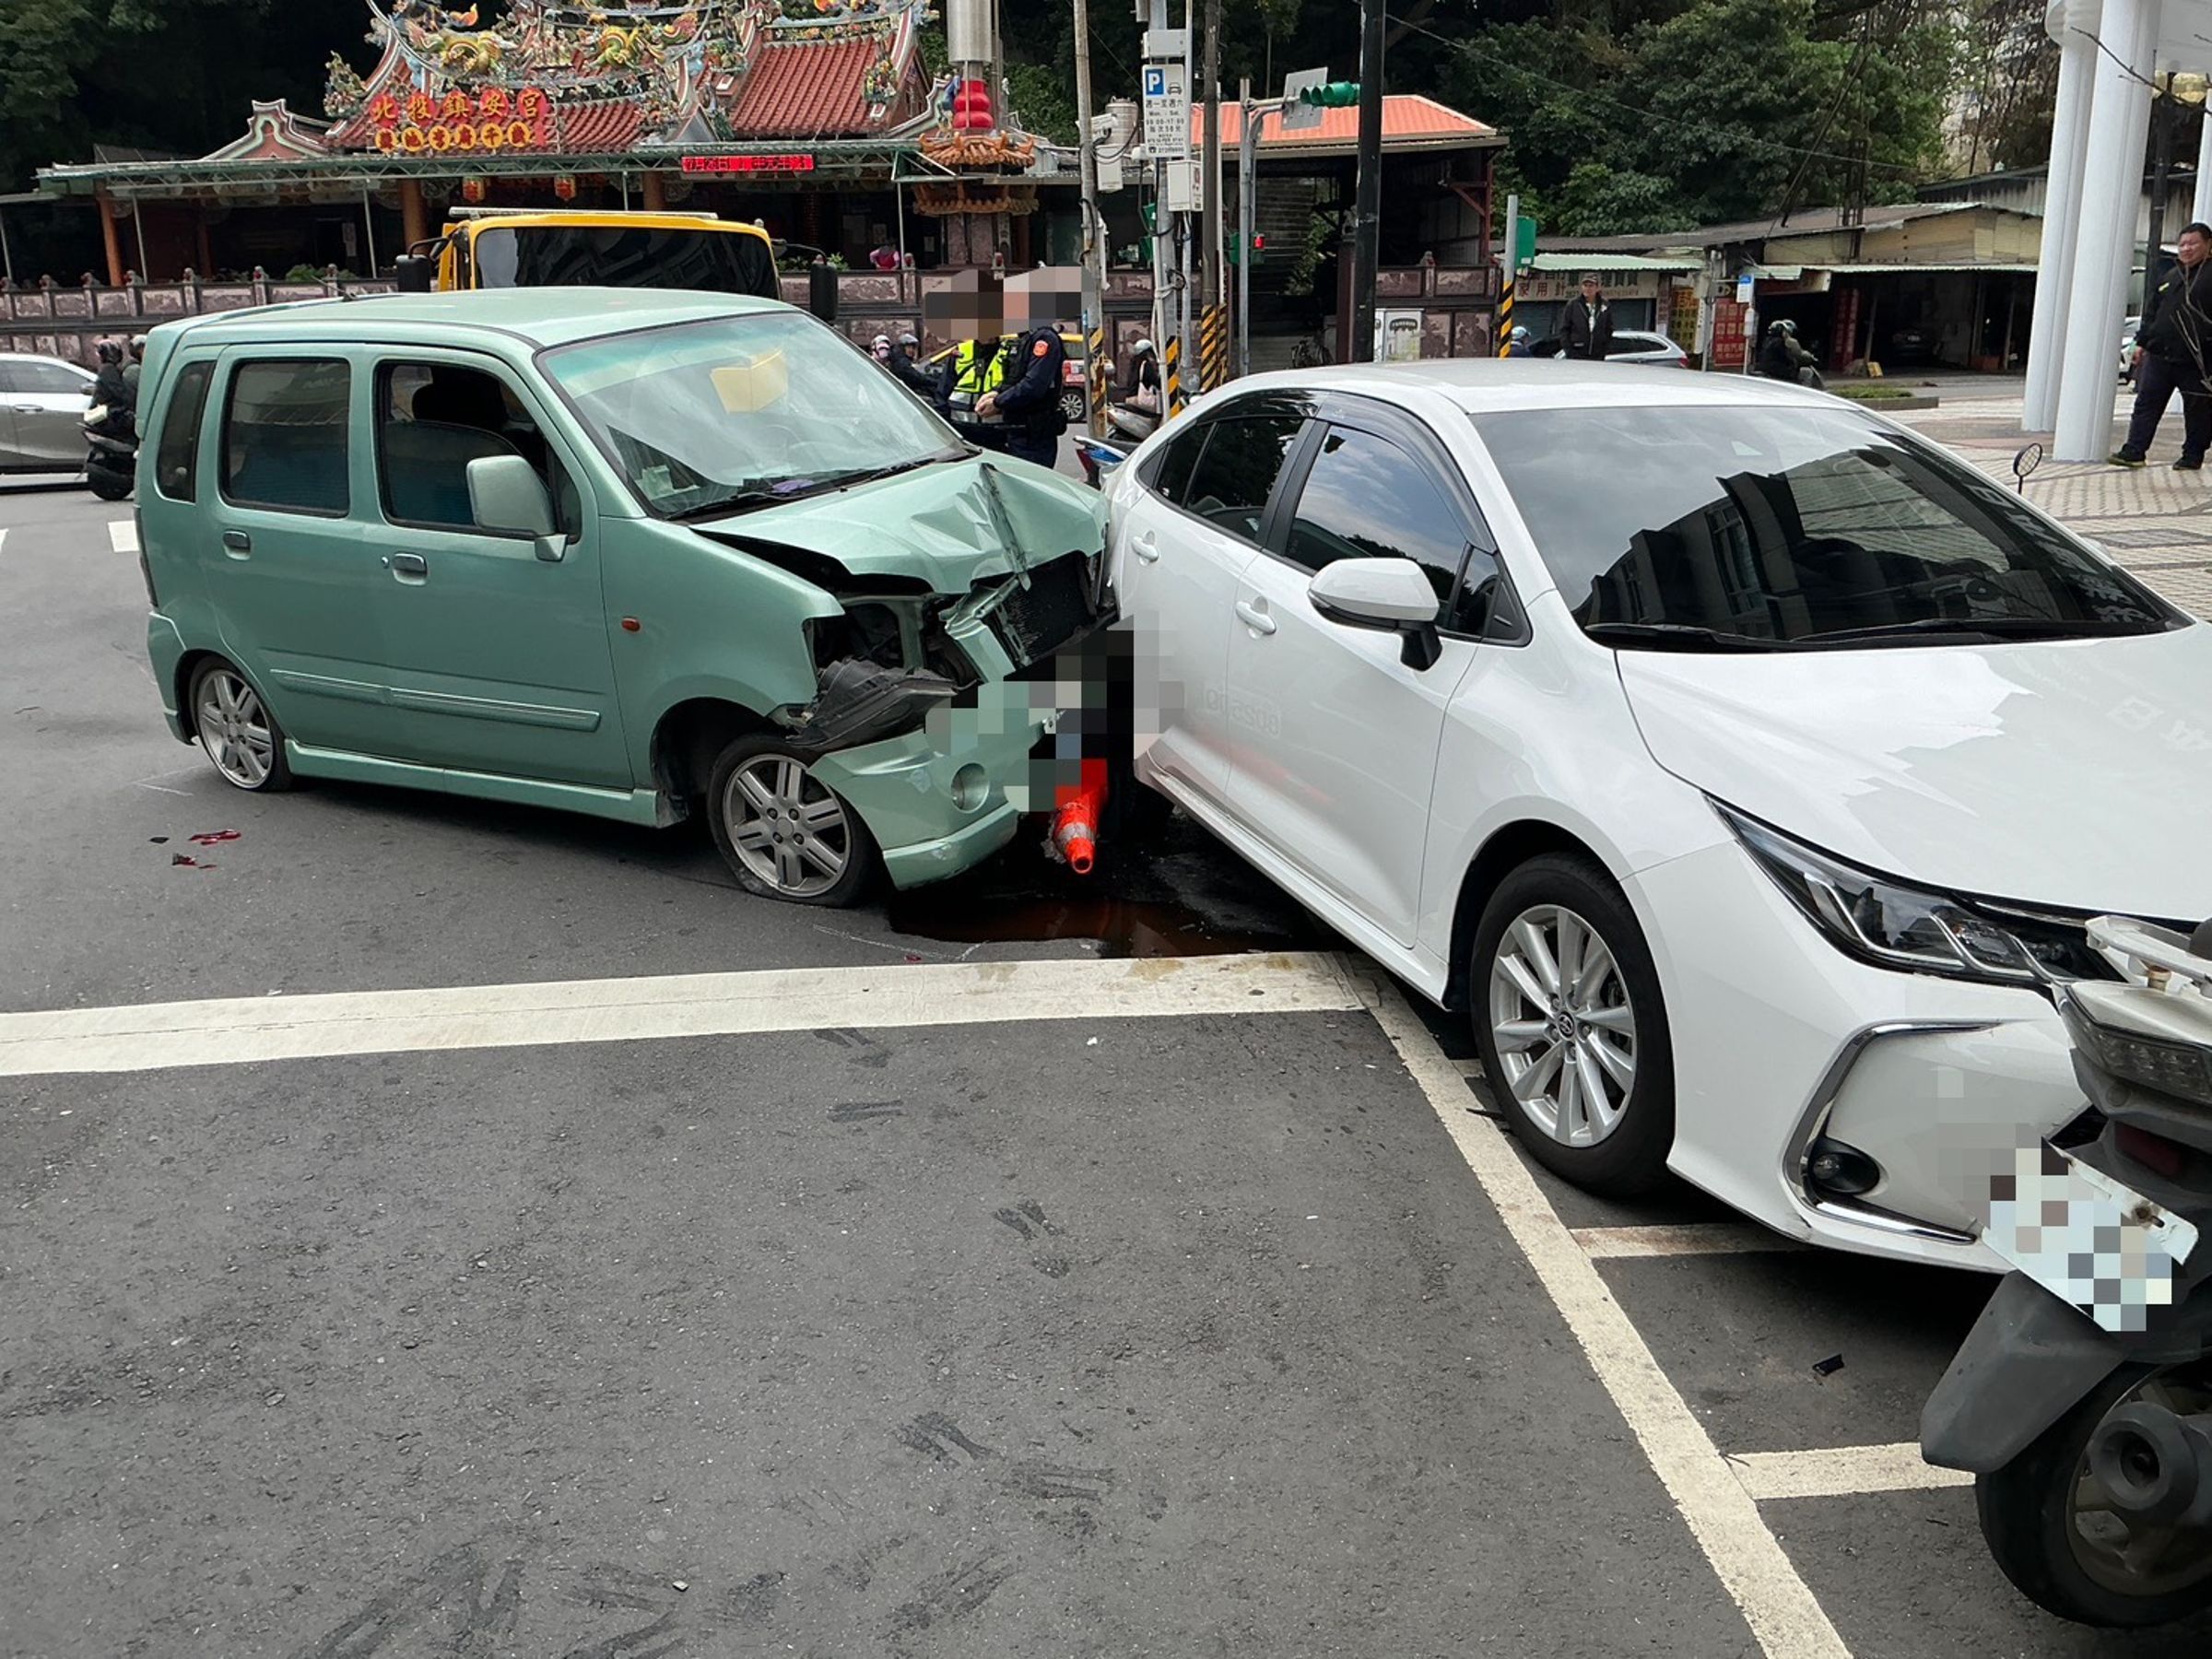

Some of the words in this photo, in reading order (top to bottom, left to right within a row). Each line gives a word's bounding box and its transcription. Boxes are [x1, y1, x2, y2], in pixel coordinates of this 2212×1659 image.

[1148, 73, 1160, 91] P
[372, 93, 540, 122] 北投鎮安宮
